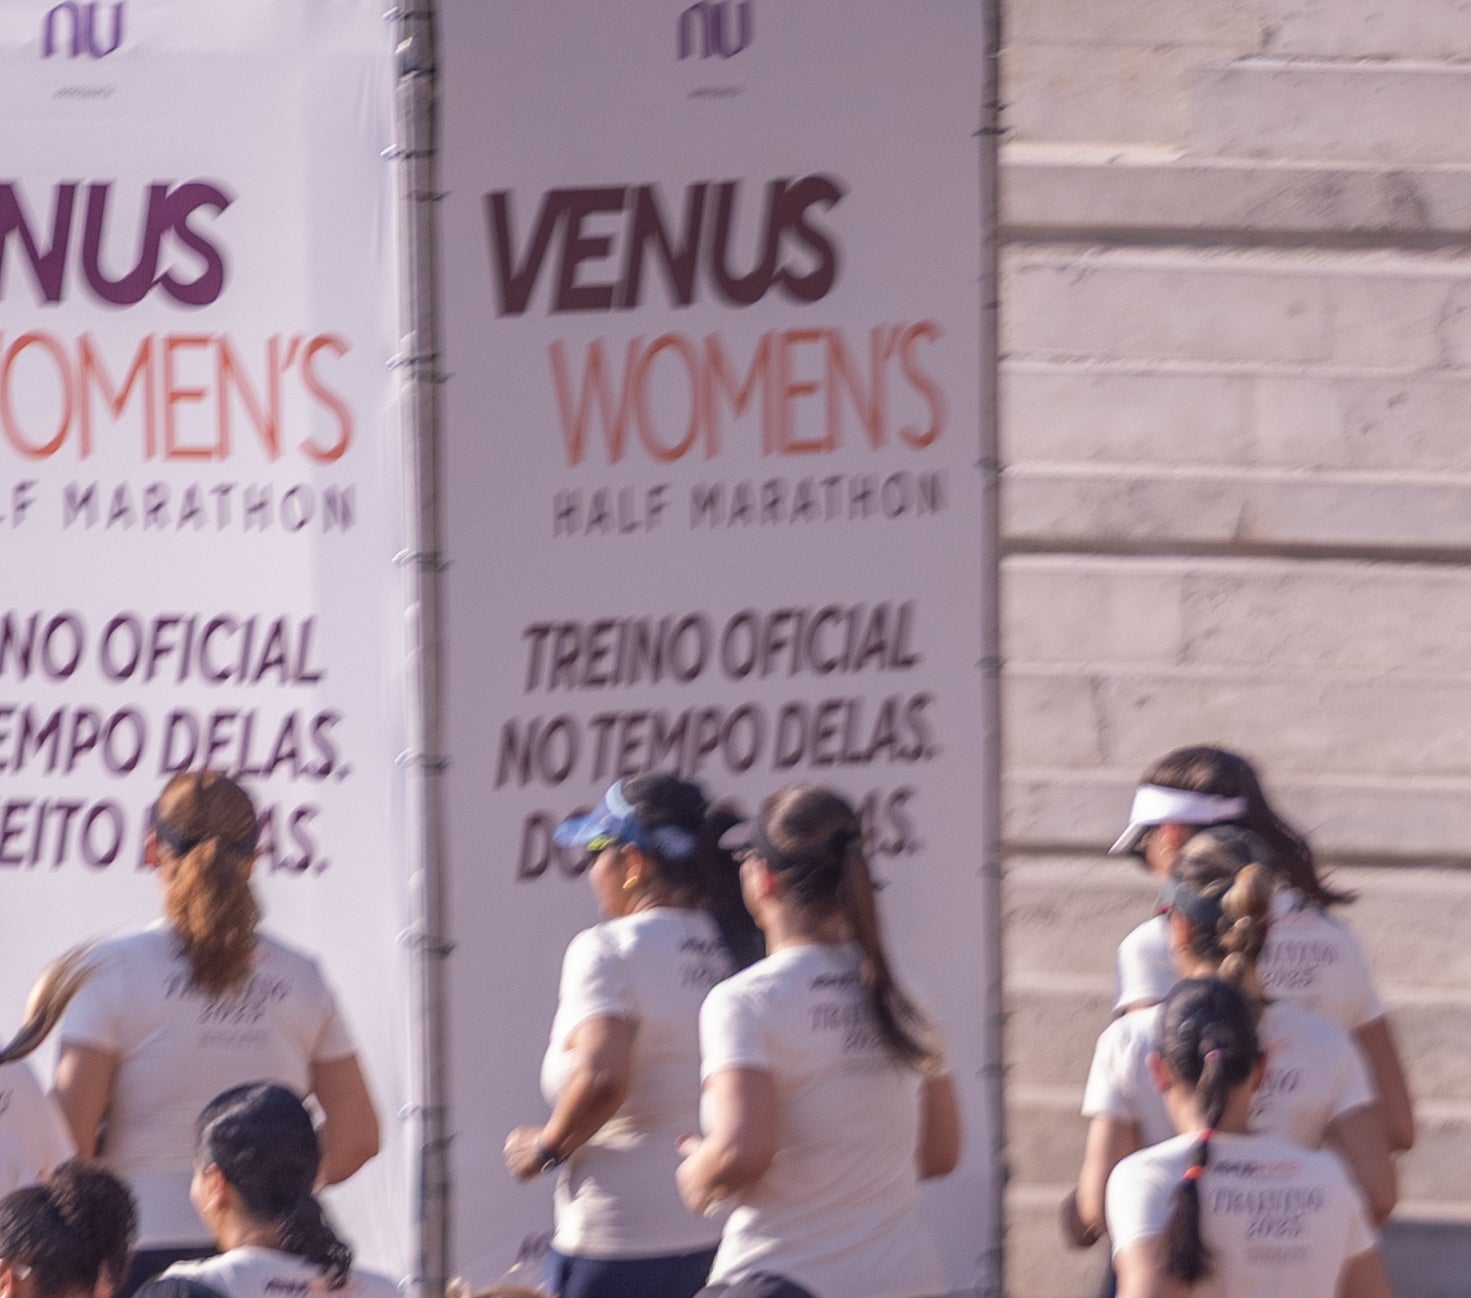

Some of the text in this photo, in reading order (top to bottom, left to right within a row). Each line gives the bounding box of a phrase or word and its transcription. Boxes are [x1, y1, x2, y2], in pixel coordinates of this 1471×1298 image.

[484, 174, 851, 319] VENUS
[547, 319, 949, 466] WOMEN'S
[62, 479, 358, 533] MARATHON
[552, 467, 951, 539] HALF MARATHON
[95, 603, 327, 689] OFICIAL
[520, 604, 922, 694] TREINO OFICIAL
[157, 706, 352, 782] DELAS.
[494, 692, 940, 789] NO TEMPO DELAS.
